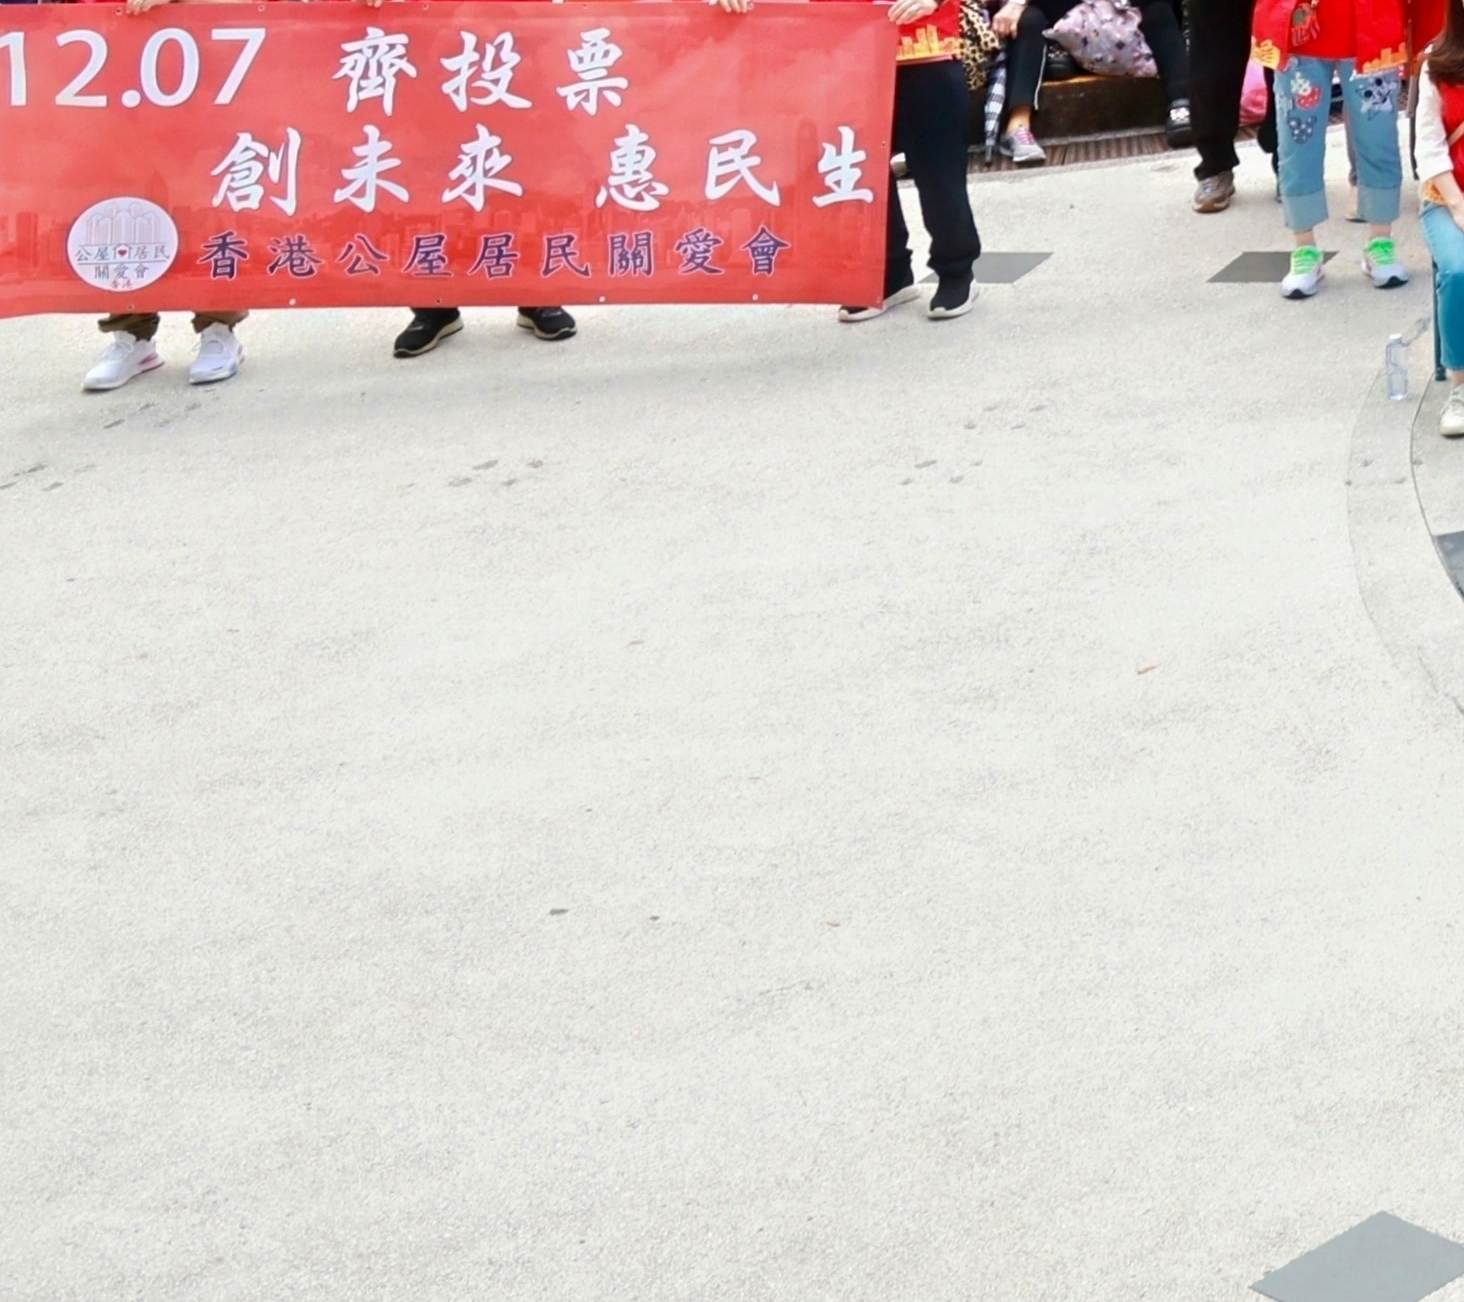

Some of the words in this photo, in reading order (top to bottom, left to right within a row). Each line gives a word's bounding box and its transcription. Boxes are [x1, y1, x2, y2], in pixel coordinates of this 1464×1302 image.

[0, 27, 266, 109] 12.07
[332, 27, 630, 117] 齊投票
[212, 124, 524, 213] 創未來
[596, 124, 875, 211] 惠民生
[199, 226, 792, 280] 香港公屋居民關愛會
